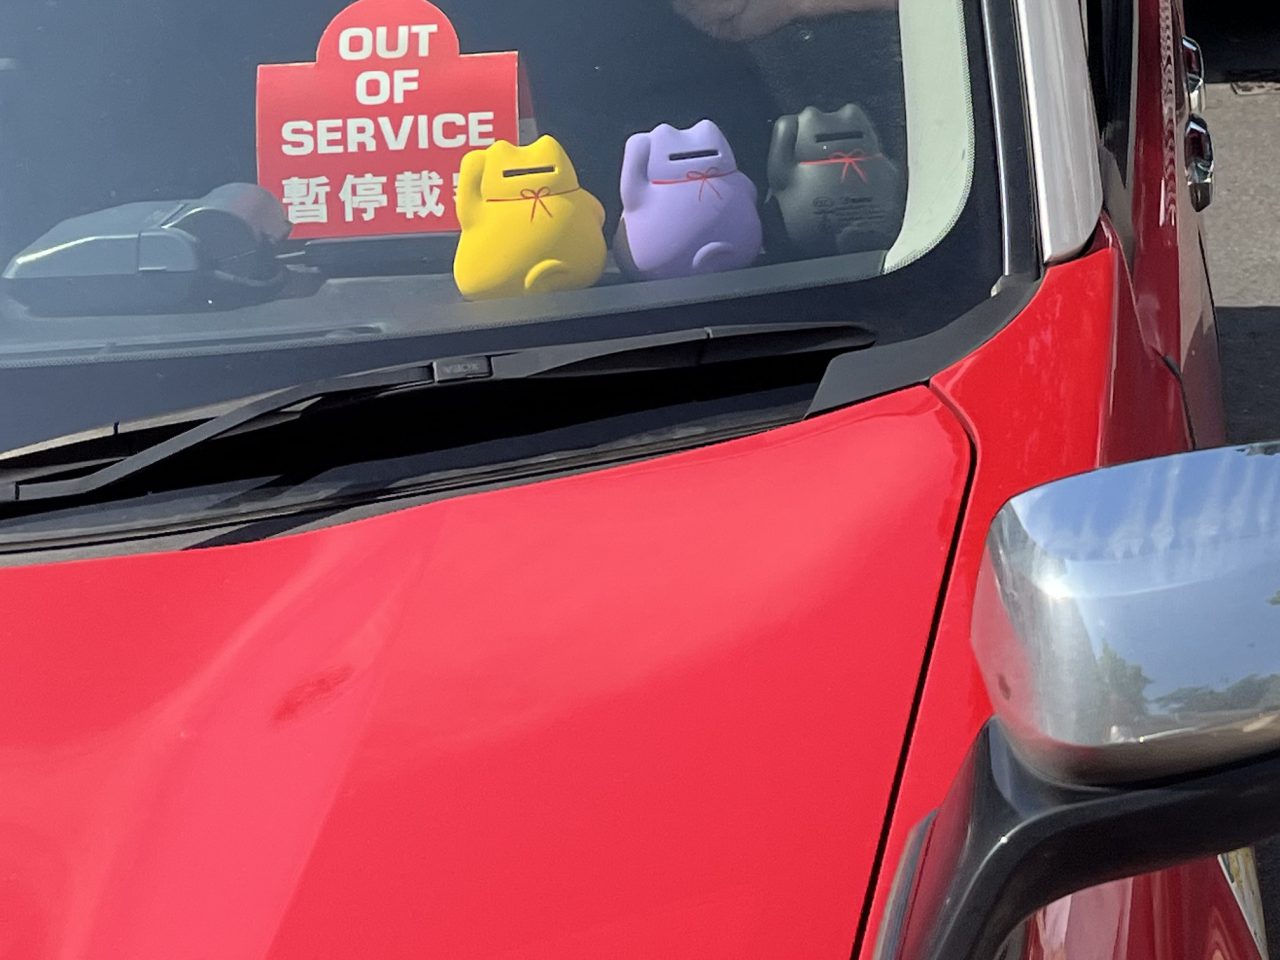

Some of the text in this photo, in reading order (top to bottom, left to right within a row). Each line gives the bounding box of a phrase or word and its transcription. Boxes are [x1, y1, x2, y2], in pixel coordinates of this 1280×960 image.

[339, 24, 439, 61] OUT
[355, 68, 419, 106] OF
[281, 111, 495, 157] SERVICE
[281, 170, 460, 225] 暫停載
